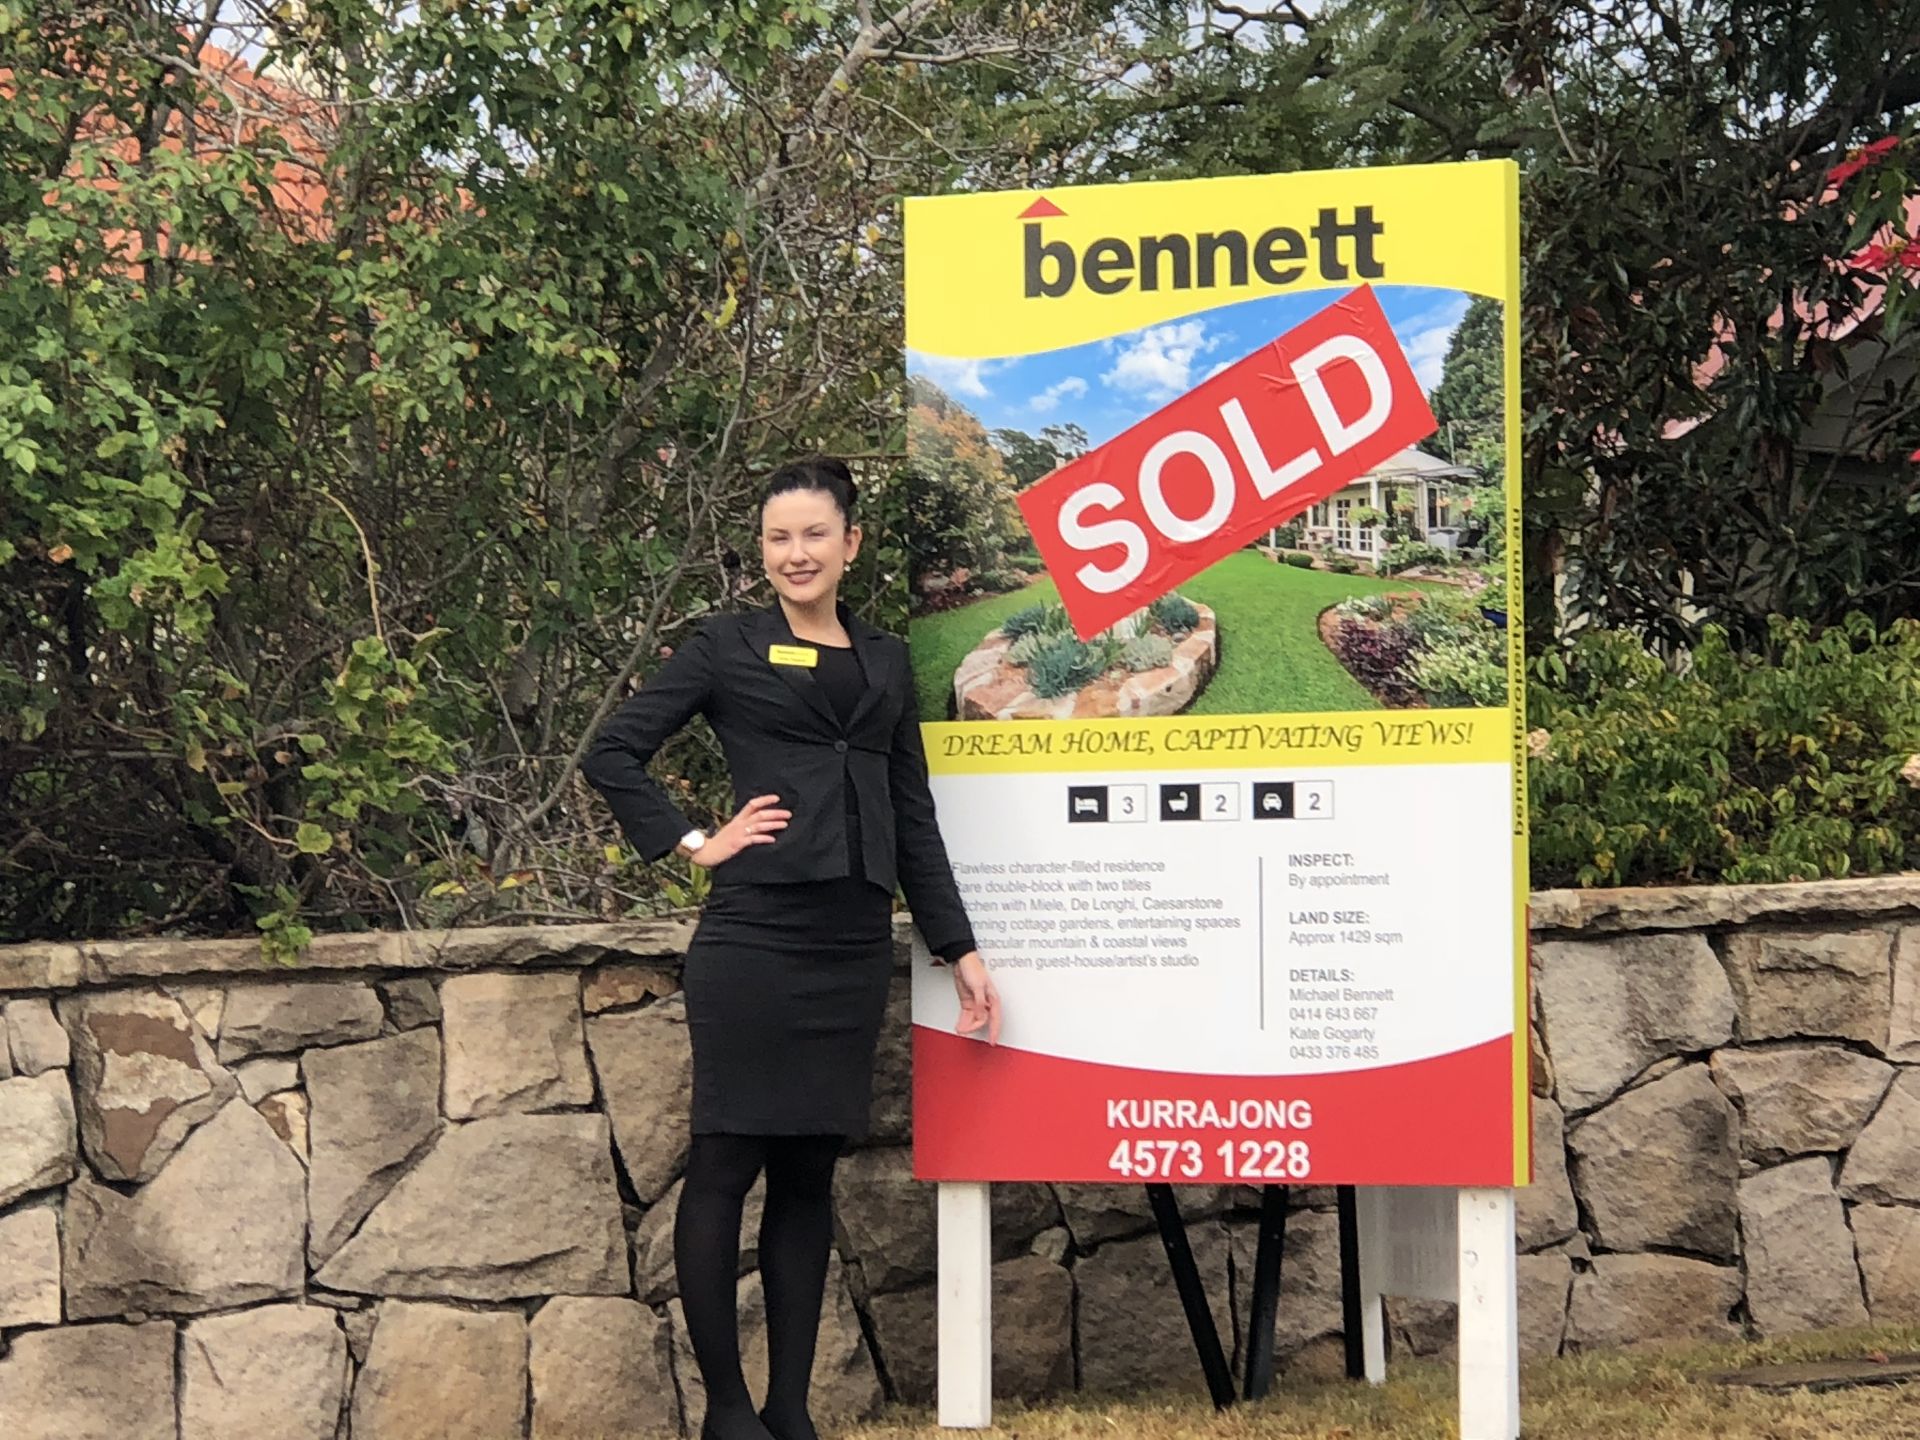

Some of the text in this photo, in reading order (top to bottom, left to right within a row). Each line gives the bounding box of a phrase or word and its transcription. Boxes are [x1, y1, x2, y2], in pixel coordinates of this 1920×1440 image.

[1023, 205, 1386, 298] bennett
[1057, 334, 1393, 594] SOLD
[1511, 507, 1525, 836] bennettproperty.com.au
[942, 720, 1474, 756] DREAM HOME, CAPTIVATING VIEWS!
[1122, 796, 1134, 814] 3
[1215, 794, 1227, 812] 2
[1309, 792, 1321, 810] 2
[951, 859, 1165, 874] Flawless character-filled residence
[1288, 853, 1354, 867] INSPECT:
[985, 879, 1064, 893] double-block
[1067, 879, 1093, 892] with
[1096, 879, 1119, 892] two
[1122, 878, 1152, 892] titles
[1288, 872, 1390, 889] By appointment
[962, 896, 1224, 914] tchen with Miele, De Longhi, Caesarstone
[971, 915, 1241, 933] nning cottage gardens, entertaining spaces
[1289, 910, 1370, 925] LAND SIZE:
[977, 934, 1188, 949] ctacular mountain & coastal views
[1289, 929, 1403, 946] Approx 1429 sqm
[988, 955, 1032, 970] garden
[1160, 953, 1200, 967] studio
[1289, 968, 1355, 982] DETAILS:
[1289, 987, 1395, 1001] Michael Bennett
[1289, 1006, 1378, 1021] 0414 643 667
[1289, 1026, 1375, 1042] Kate Gogarty
[1289, 1045, 1379, 1060] 0433 376 485
[1106, 1099, 1313, 1129] KURRAJONG
[1108, 1139, 1311, 1178] 4573 1228
